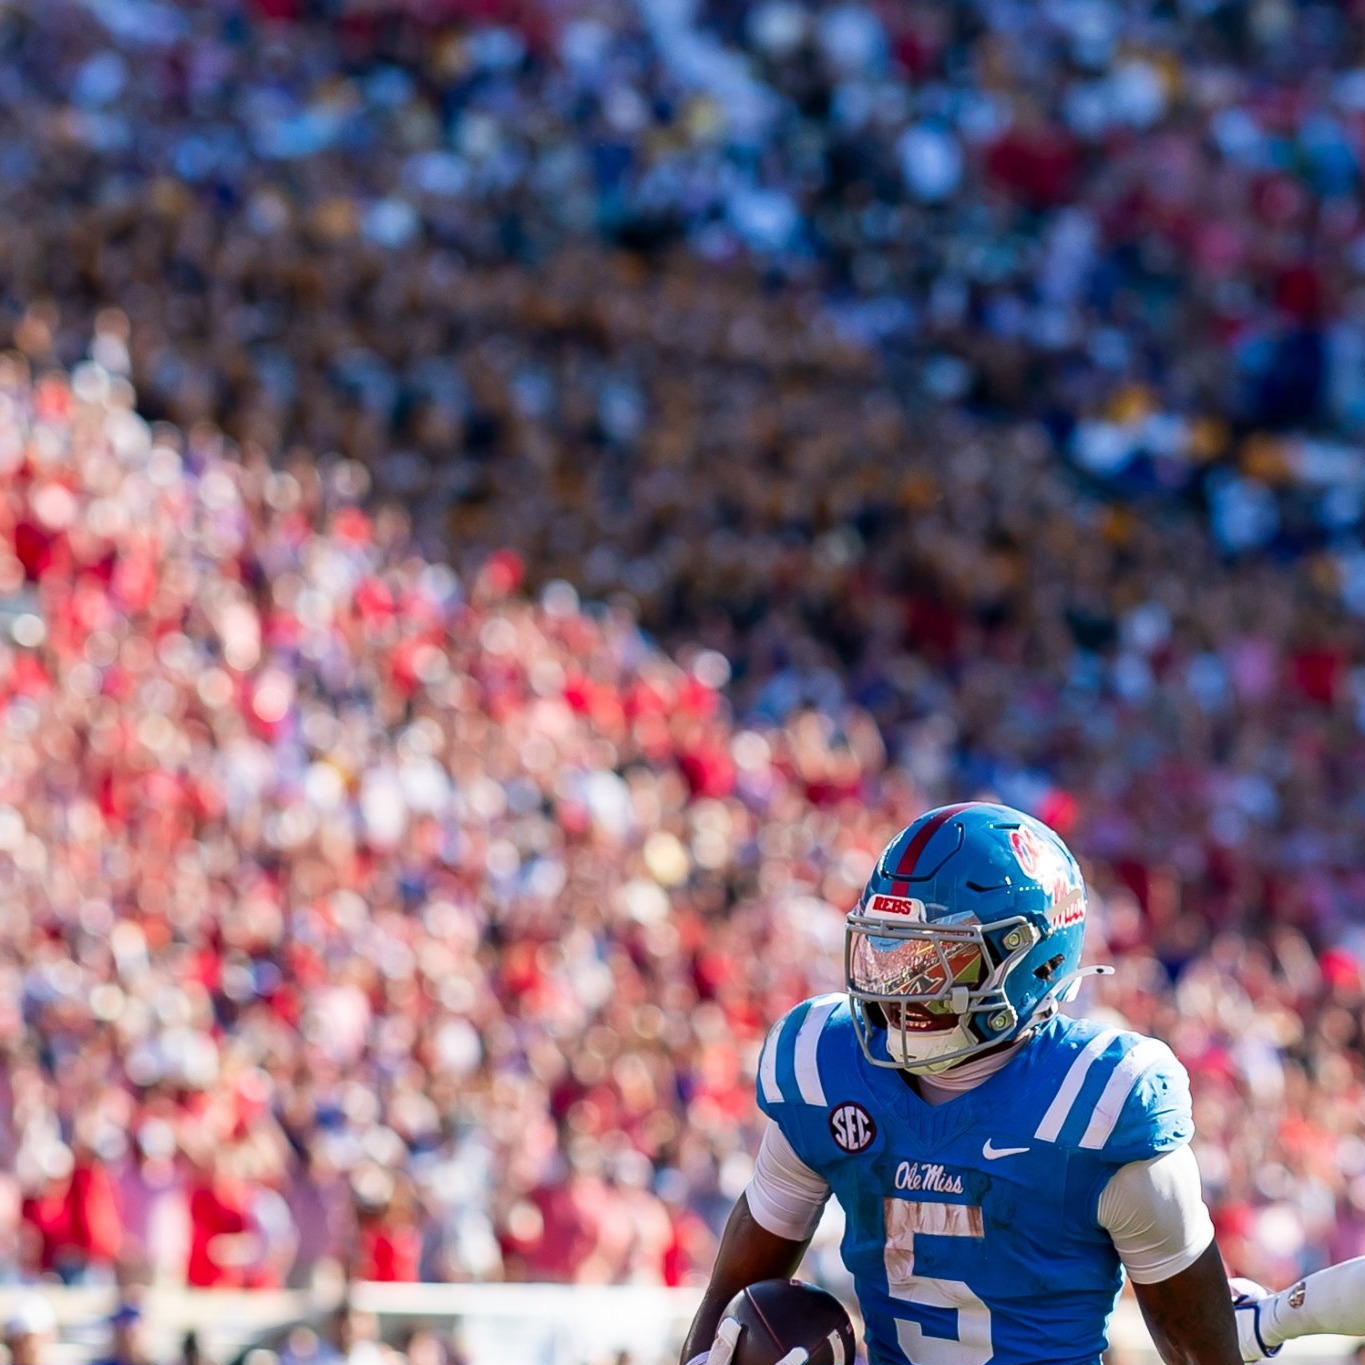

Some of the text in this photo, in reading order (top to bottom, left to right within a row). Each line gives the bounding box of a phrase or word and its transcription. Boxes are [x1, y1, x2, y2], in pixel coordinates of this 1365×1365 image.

[873, 896, 912, 915] REBS
[831, 1105, 872, 1151] SEC
[894, 1161, 964, 1194] Ole Miss
